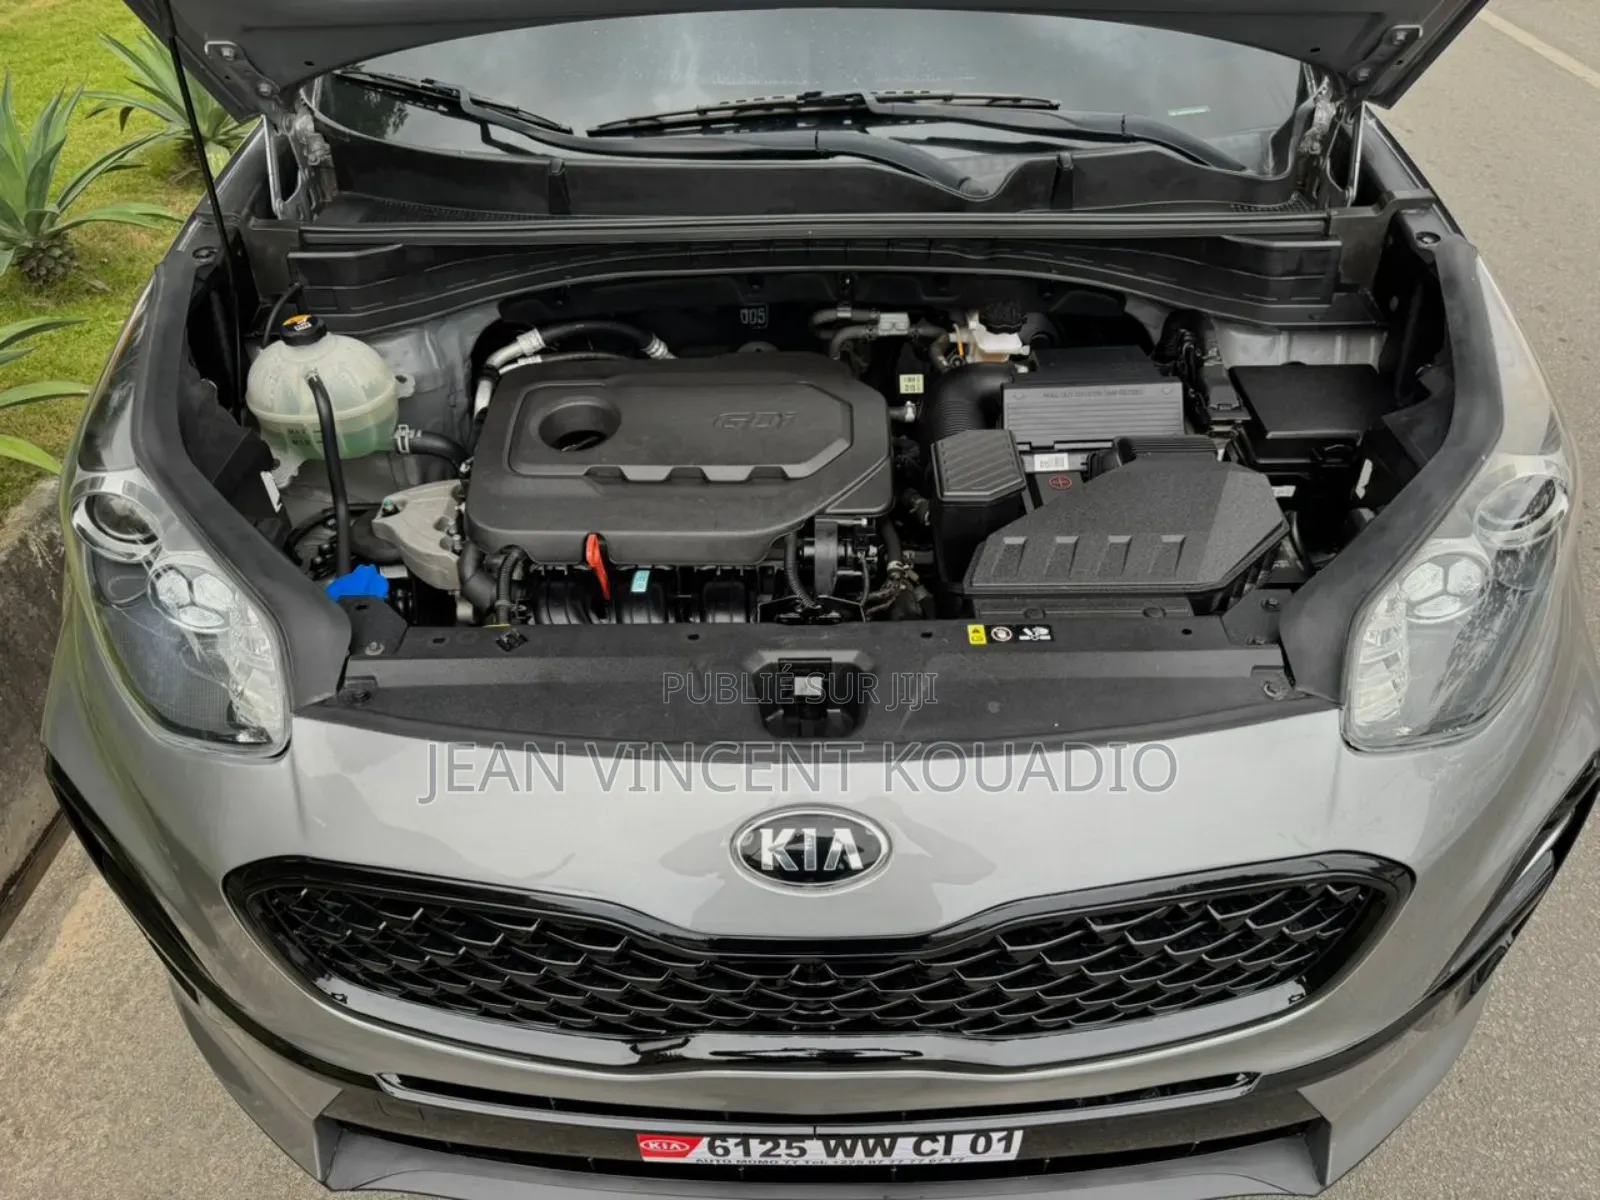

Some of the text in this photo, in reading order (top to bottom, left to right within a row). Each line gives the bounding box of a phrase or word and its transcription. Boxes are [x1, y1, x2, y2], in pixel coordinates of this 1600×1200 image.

[760, 827, 864, 872] KIA
[650, 1142, 679, 1150] KIA
[707, 1135, 808, 1158] 6125
[819, 1135, 899, 1158] WW
[969, 1130, 1015, 1155] 01
